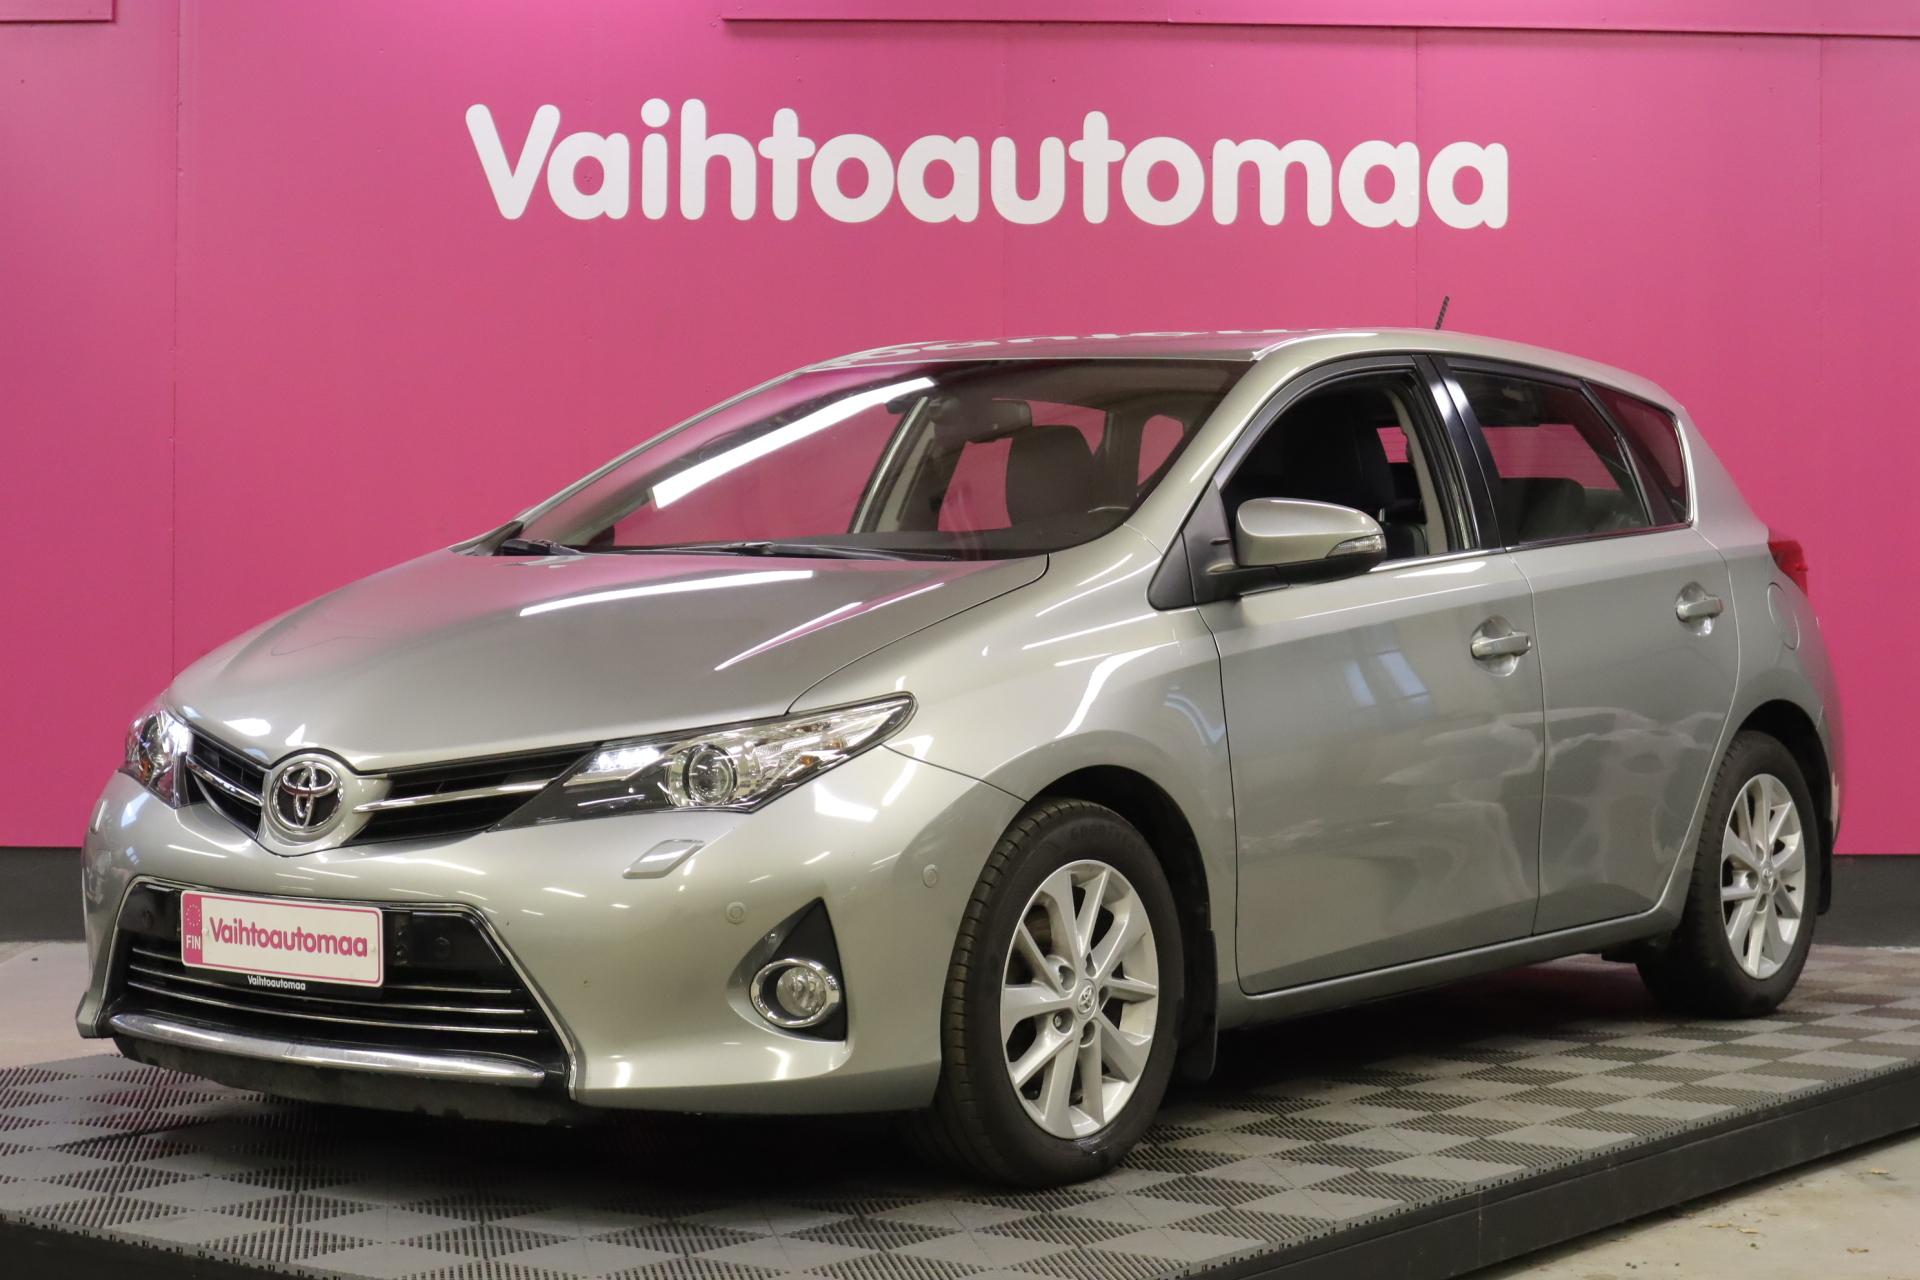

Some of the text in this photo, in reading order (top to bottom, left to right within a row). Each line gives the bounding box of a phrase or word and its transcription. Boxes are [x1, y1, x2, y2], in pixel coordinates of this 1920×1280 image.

[466, 98, 1508, 230] Vaihtoautomaa
[186, 935, 200, 949] FIN
[209, 917, 367, 957] Vaihtoautomaa
[247, 975, 306, 990] Vaihtoautomaa
